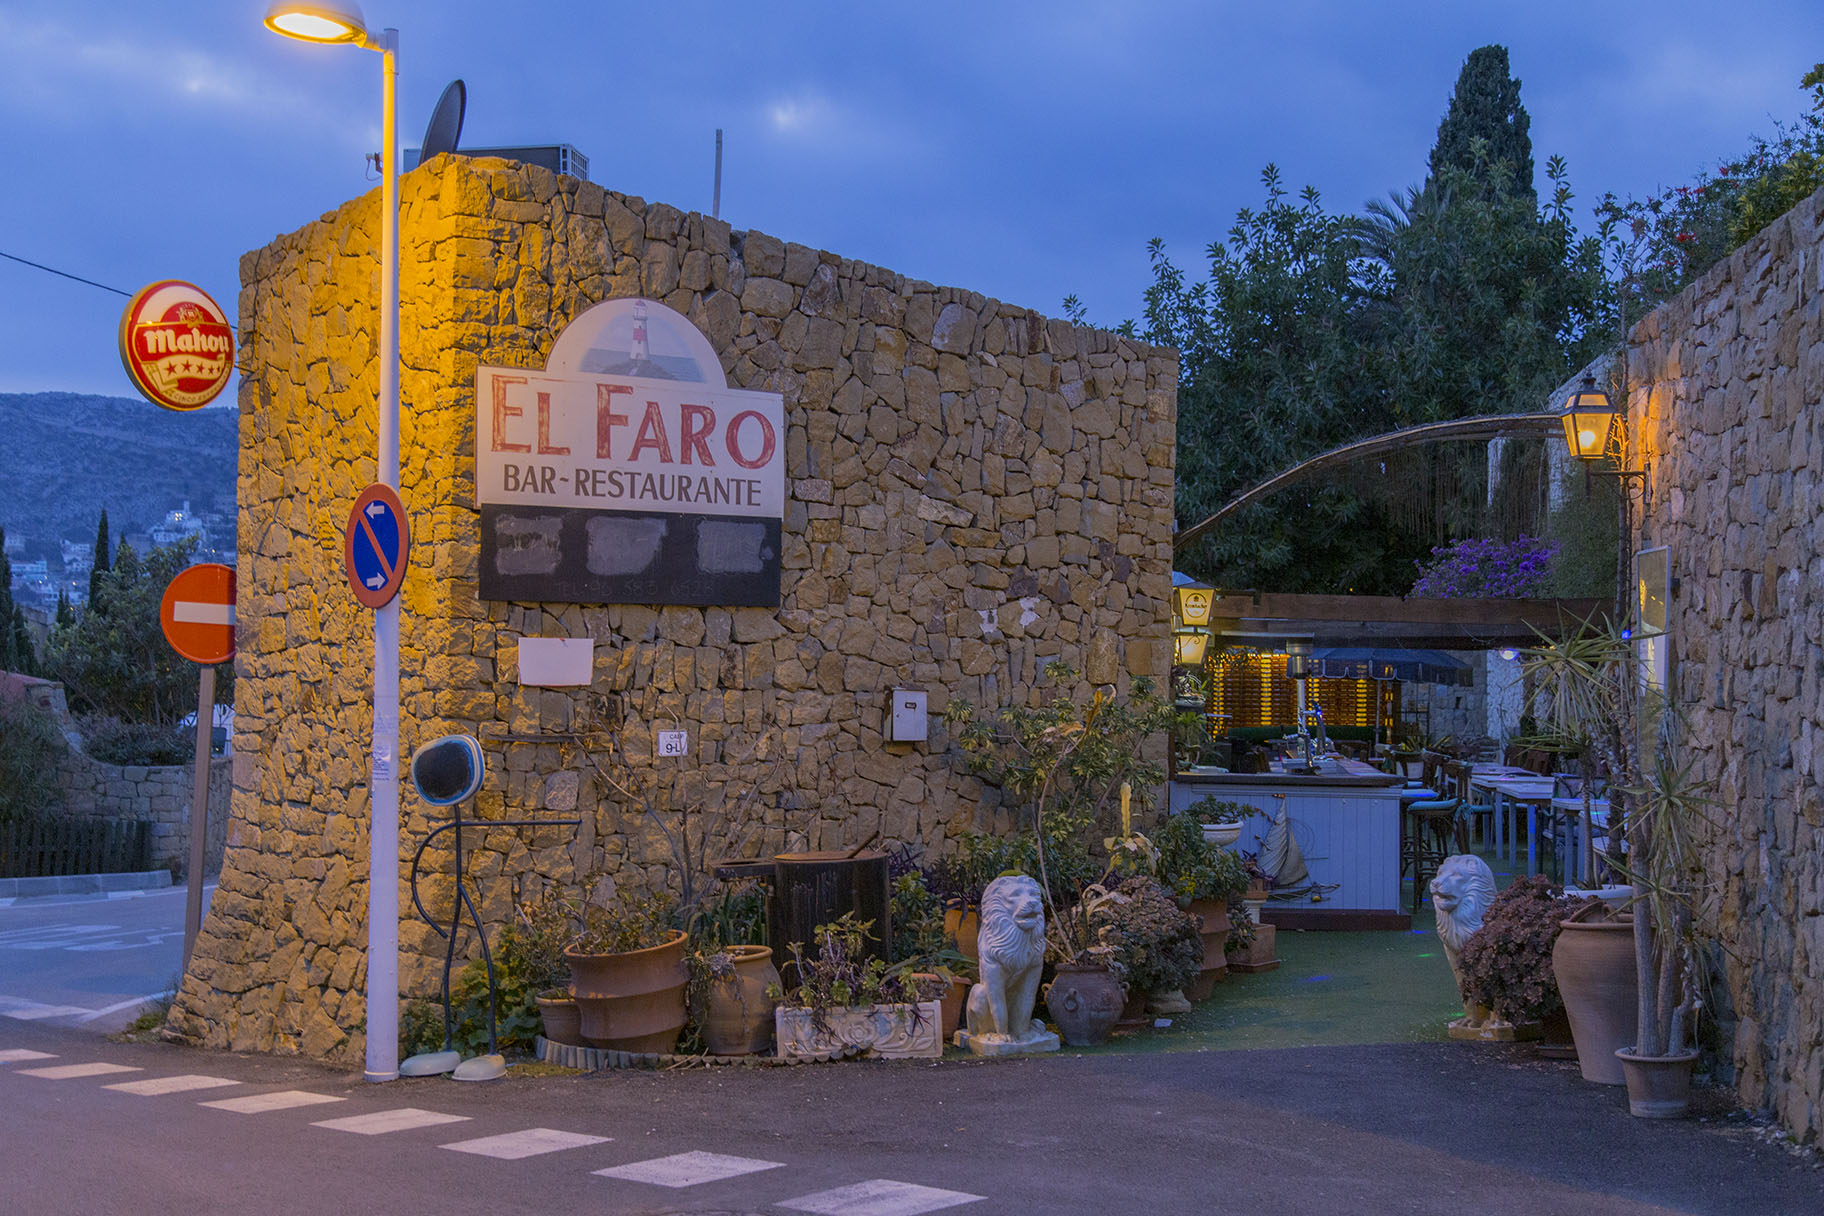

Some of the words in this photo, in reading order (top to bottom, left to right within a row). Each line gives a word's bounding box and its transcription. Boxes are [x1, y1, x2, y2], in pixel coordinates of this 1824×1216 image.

[143, 327, 230, 353] Mahou
[491, 374, 571, 456] EL
[596, 383, 776, 470] FARO
[503, 463, 761, 507] BAR-RESTAURANTE
